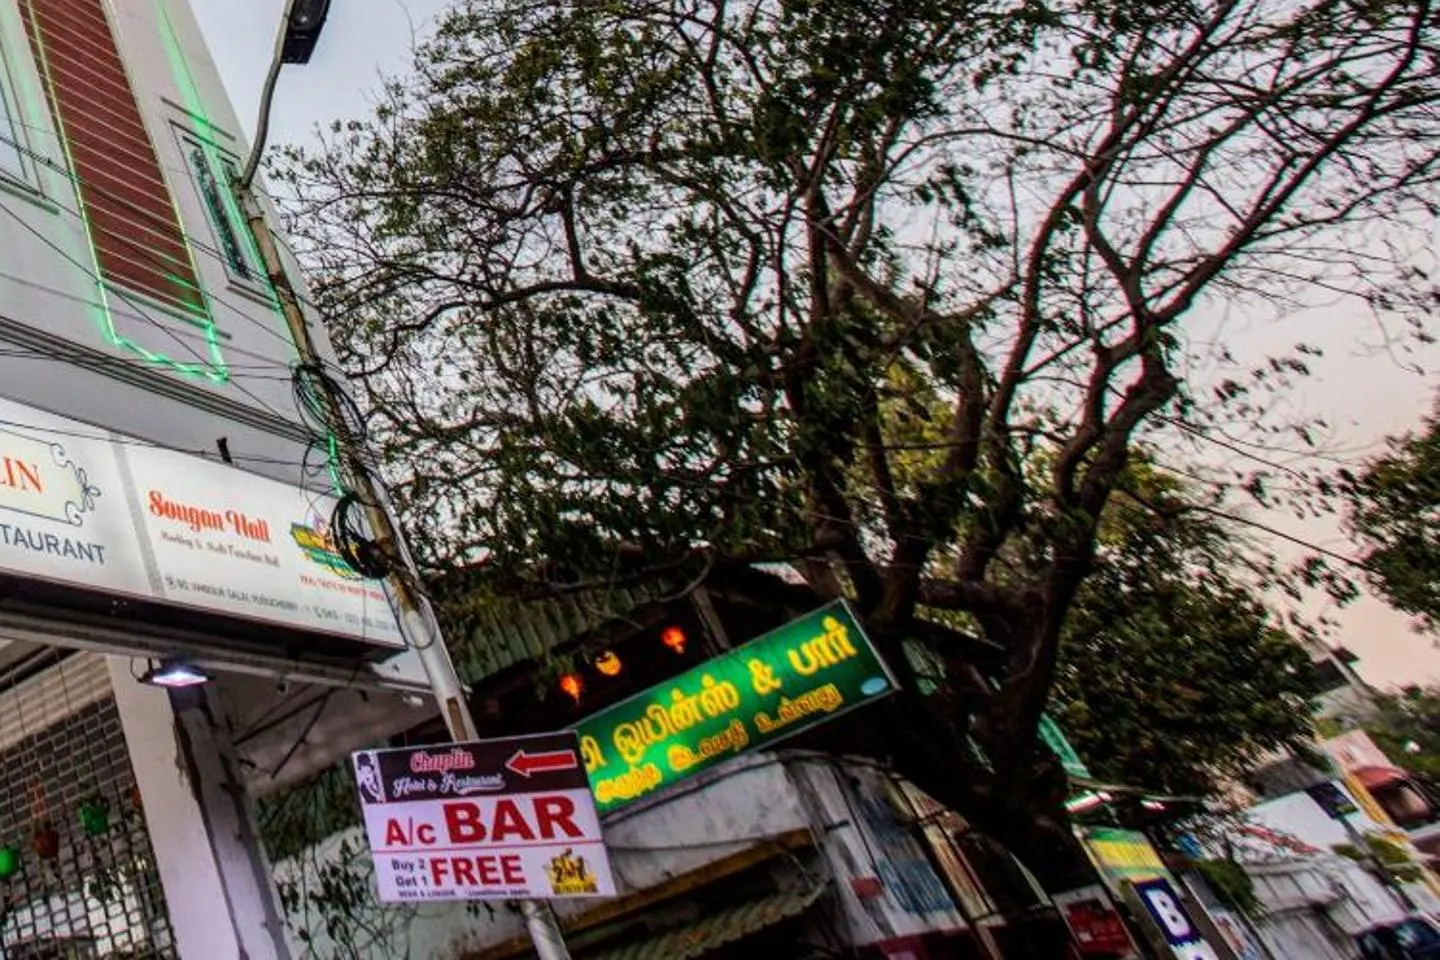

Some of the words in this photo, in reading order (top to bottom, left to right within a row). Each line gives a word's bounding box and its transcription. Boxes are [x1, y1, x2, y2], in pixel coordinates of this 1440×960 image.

[748, 658, 783, 695] &
[787, 615, 857, 676] பார்
[442, 795, 585, 845] BAR
[392, 858, 415, 872] Buy
[429, 855, 527, 886] FREE
[395, 875, 418, 887] Get
